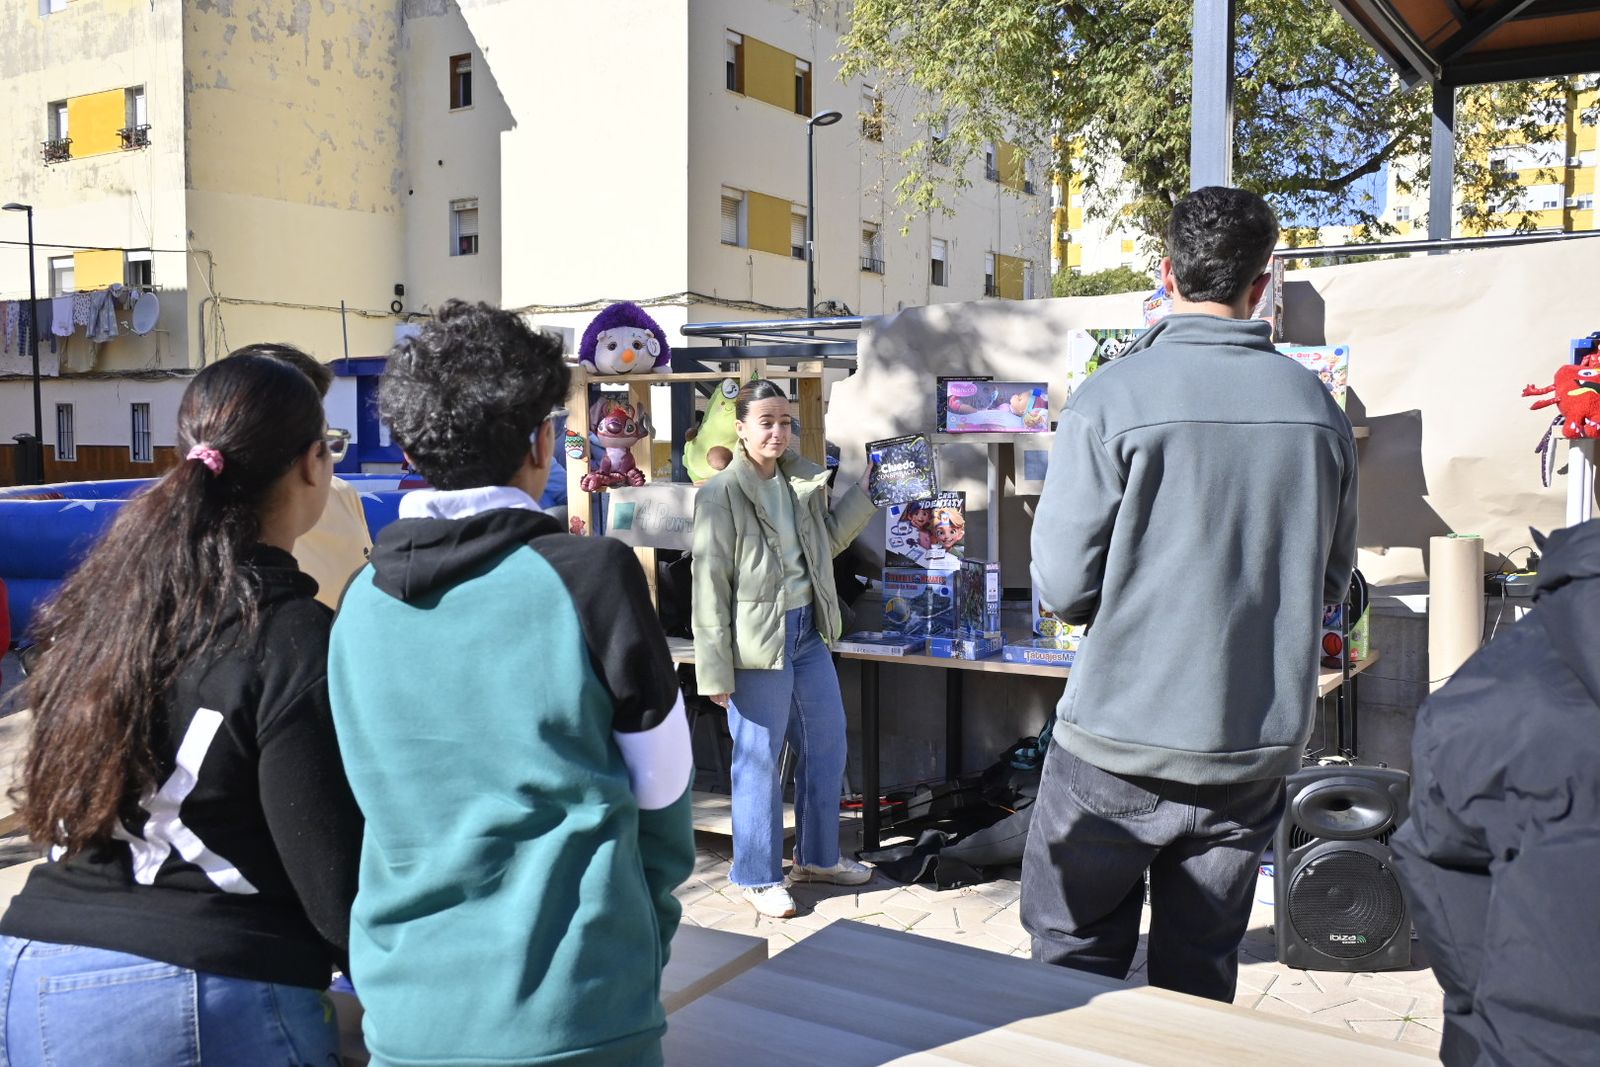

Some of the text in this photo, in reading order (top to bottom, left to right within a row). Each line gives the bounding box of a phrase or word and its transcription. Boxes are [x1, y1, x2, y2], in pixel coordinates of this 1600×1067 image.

[881, 460, 915, 473] Cluedo
[919, 498, 963, 509] IDENTITY
[1329, 933, 1357, 941] ibiza
